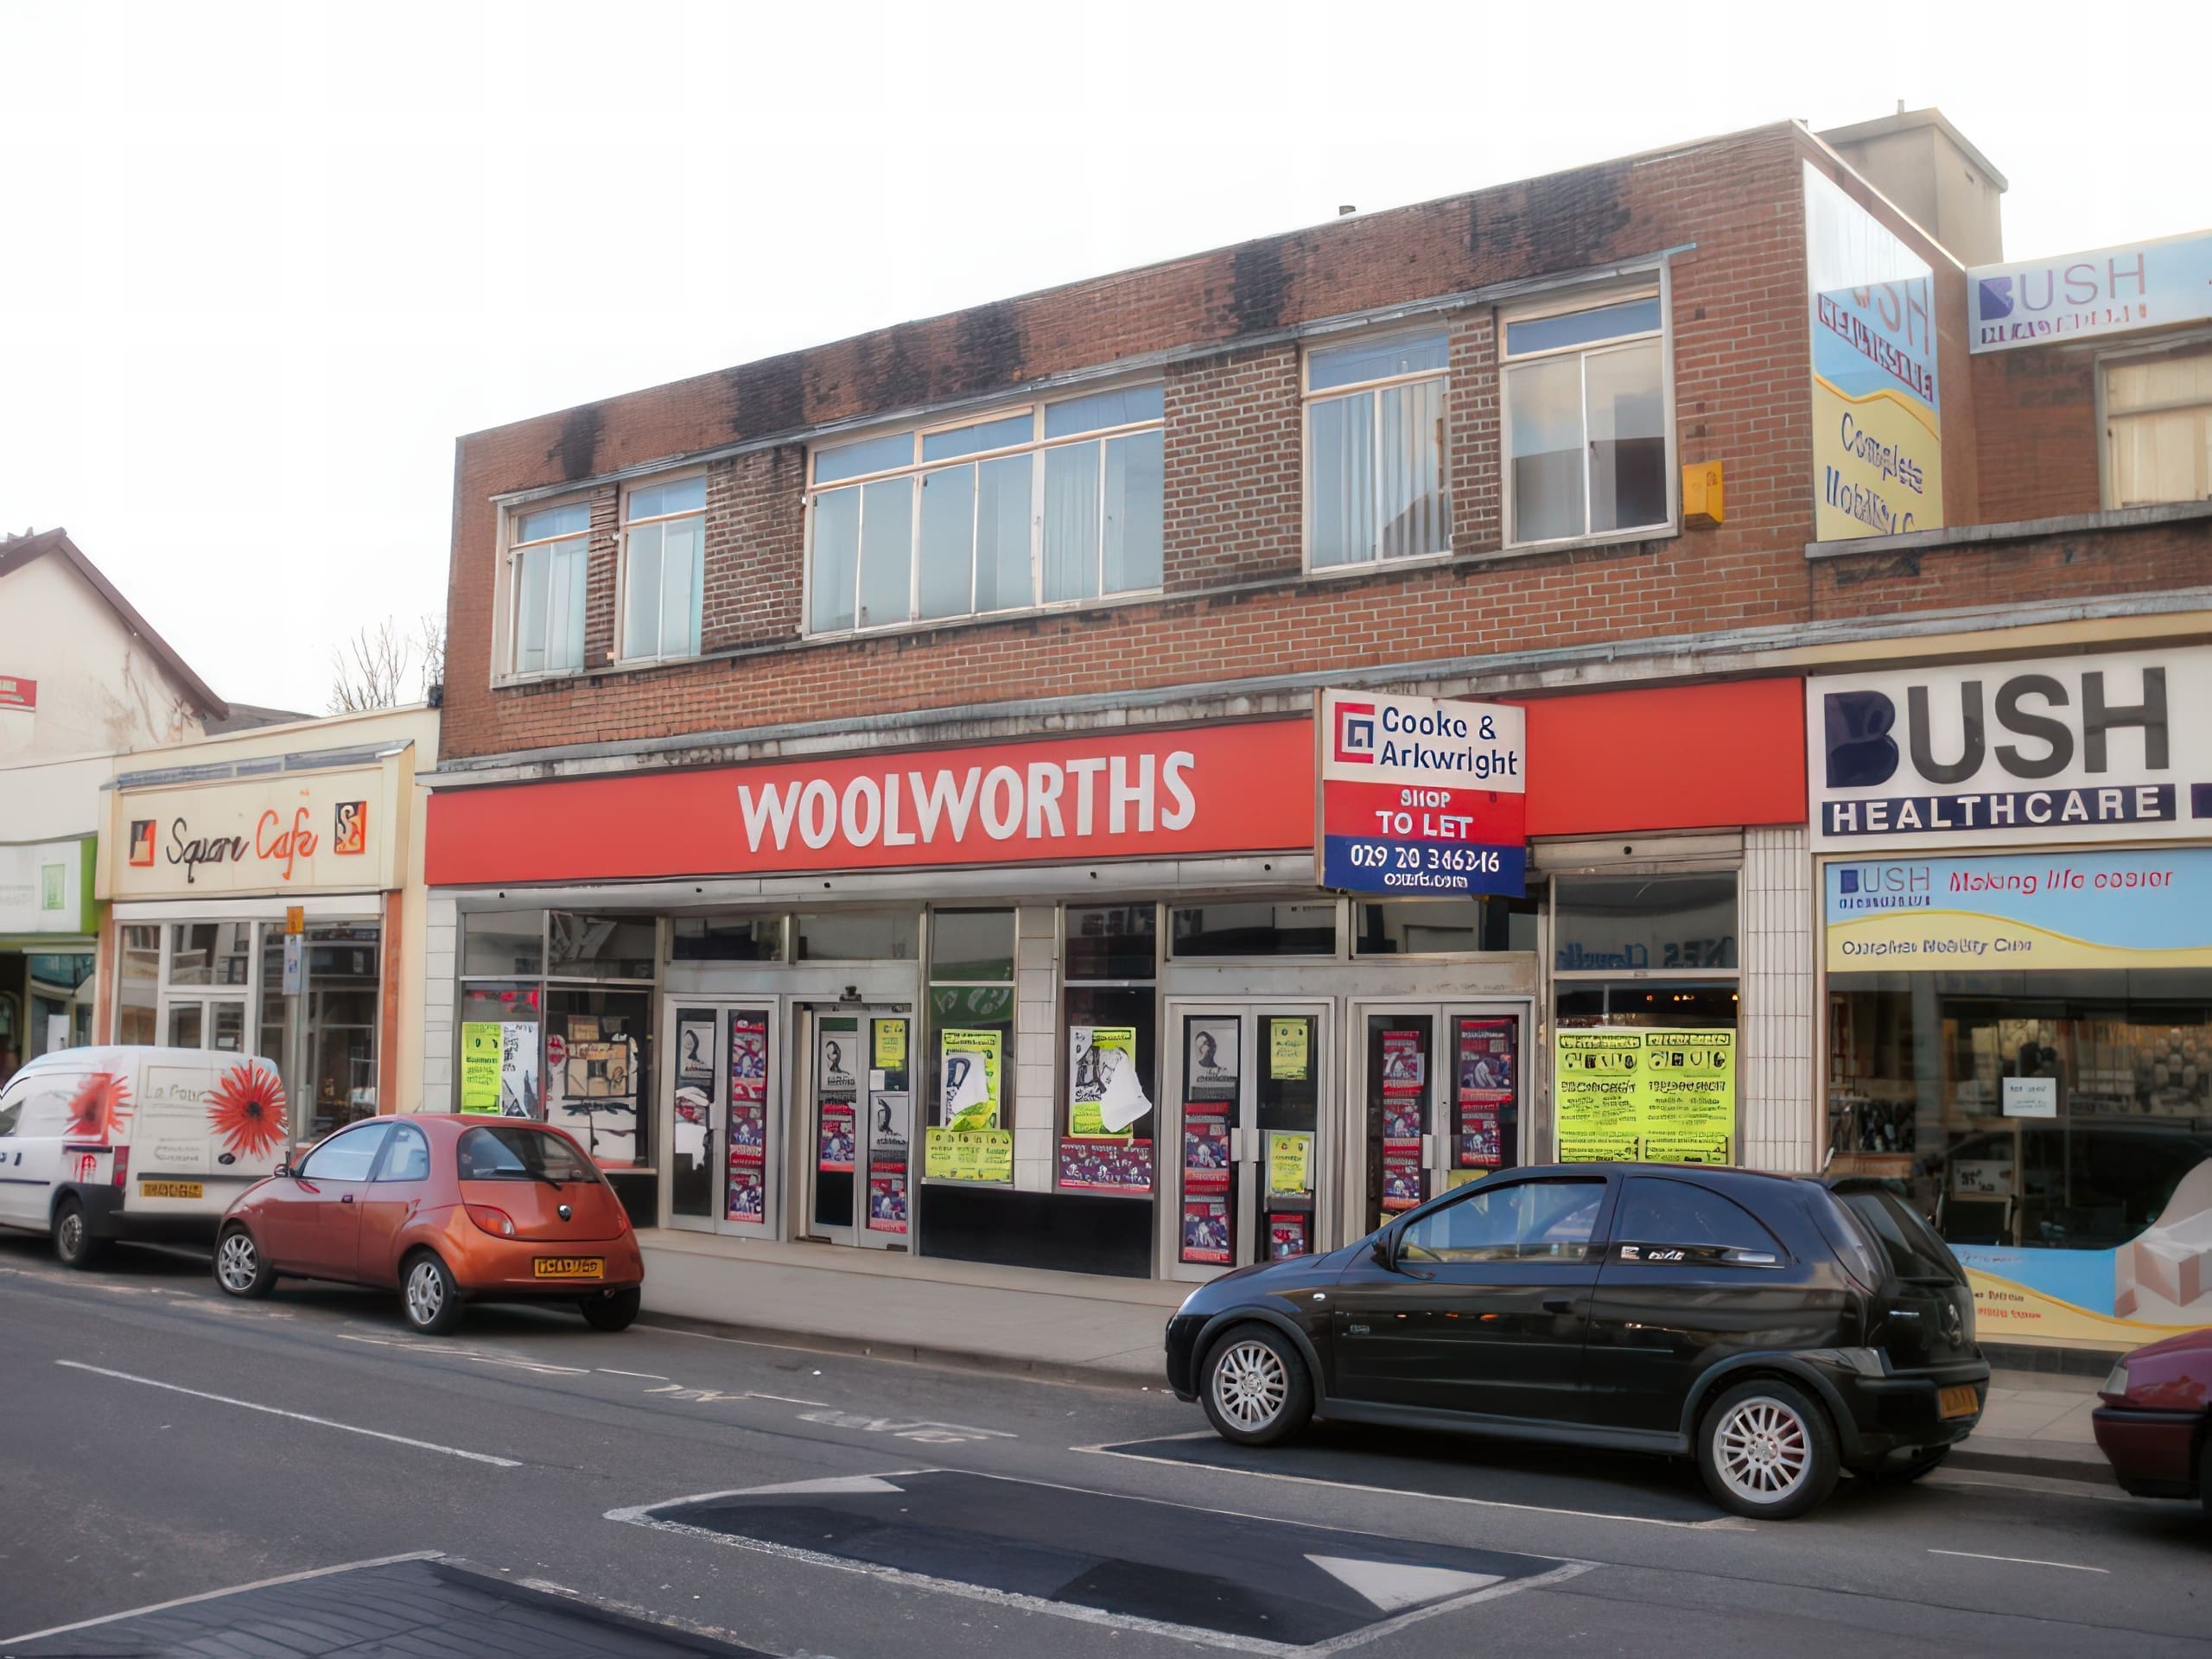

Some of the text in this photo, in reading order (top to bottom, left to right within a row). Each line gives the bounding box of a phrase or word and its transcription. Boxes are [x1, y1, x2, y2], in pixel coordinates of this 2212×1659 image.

[1979, 252, 2146, 321] BUSH
[1478, 715, 1497, 740] &
[1823, 666, 2170, 788] BUSH
[1380, 741, 1517, 779] Arkwright
[737, 750, 1197, 853] WOOLWORTHS
[1832, 786, 2161, 832] HEALTHCARE
[1376, 810, 1473, 839] TO LET
[1351, 844, 1388, 868] 029
[1395, 847, 1421, 868] 20
